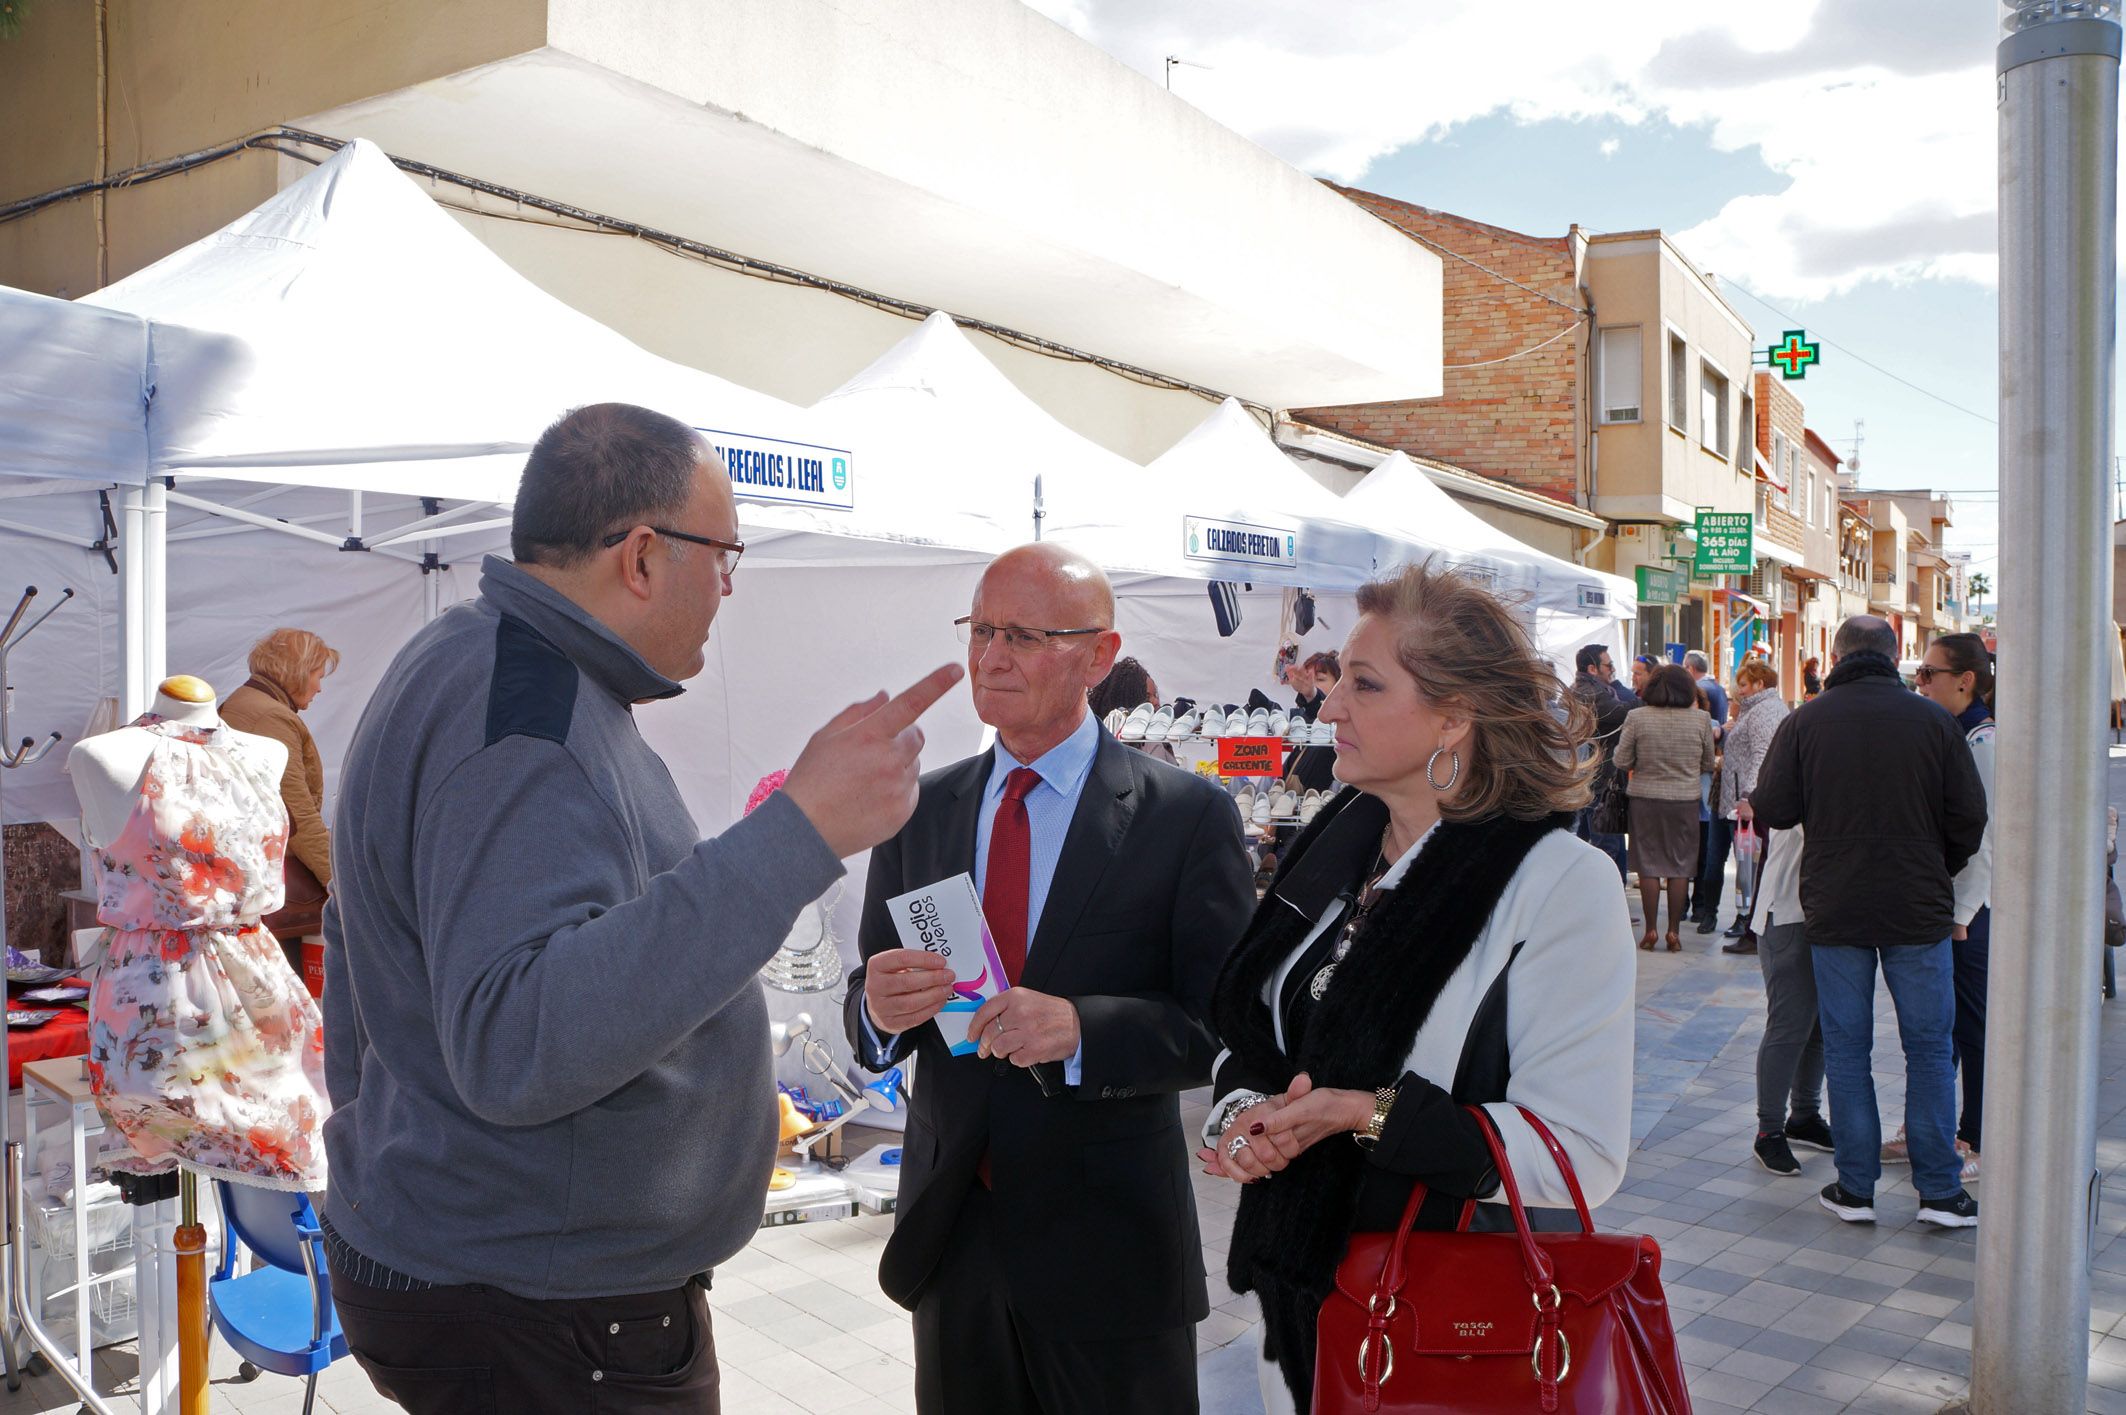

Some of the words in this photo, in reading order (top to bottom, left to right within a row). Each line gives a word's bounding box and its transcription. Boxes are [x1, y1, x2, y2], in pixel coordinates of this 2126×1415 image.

[728, 447, 784, 488] REGALOS
[787, 456, 796, 489] J.
[798, 457, 824, 493] LEAL
[1702, 515, 1748, 526] ABIERTO
[1207, 527, 1247, 554] CALZADOS
[1248, 533, 1281, 558] PERETON
[1701, 536, 1727, 548] 365
[1728, 536, 1748, 548] DÍAS
[1708, 548, 1719, 557] AL
[1721, 546, 1741, 557] AÑO
[1232, 744, 1269, 757] ZONA
[921, 895, 952, 957] eventos
[1452, 1322, 1494, 1330] TOSCA
[1459, 1329, 1486, 1337] BLU
